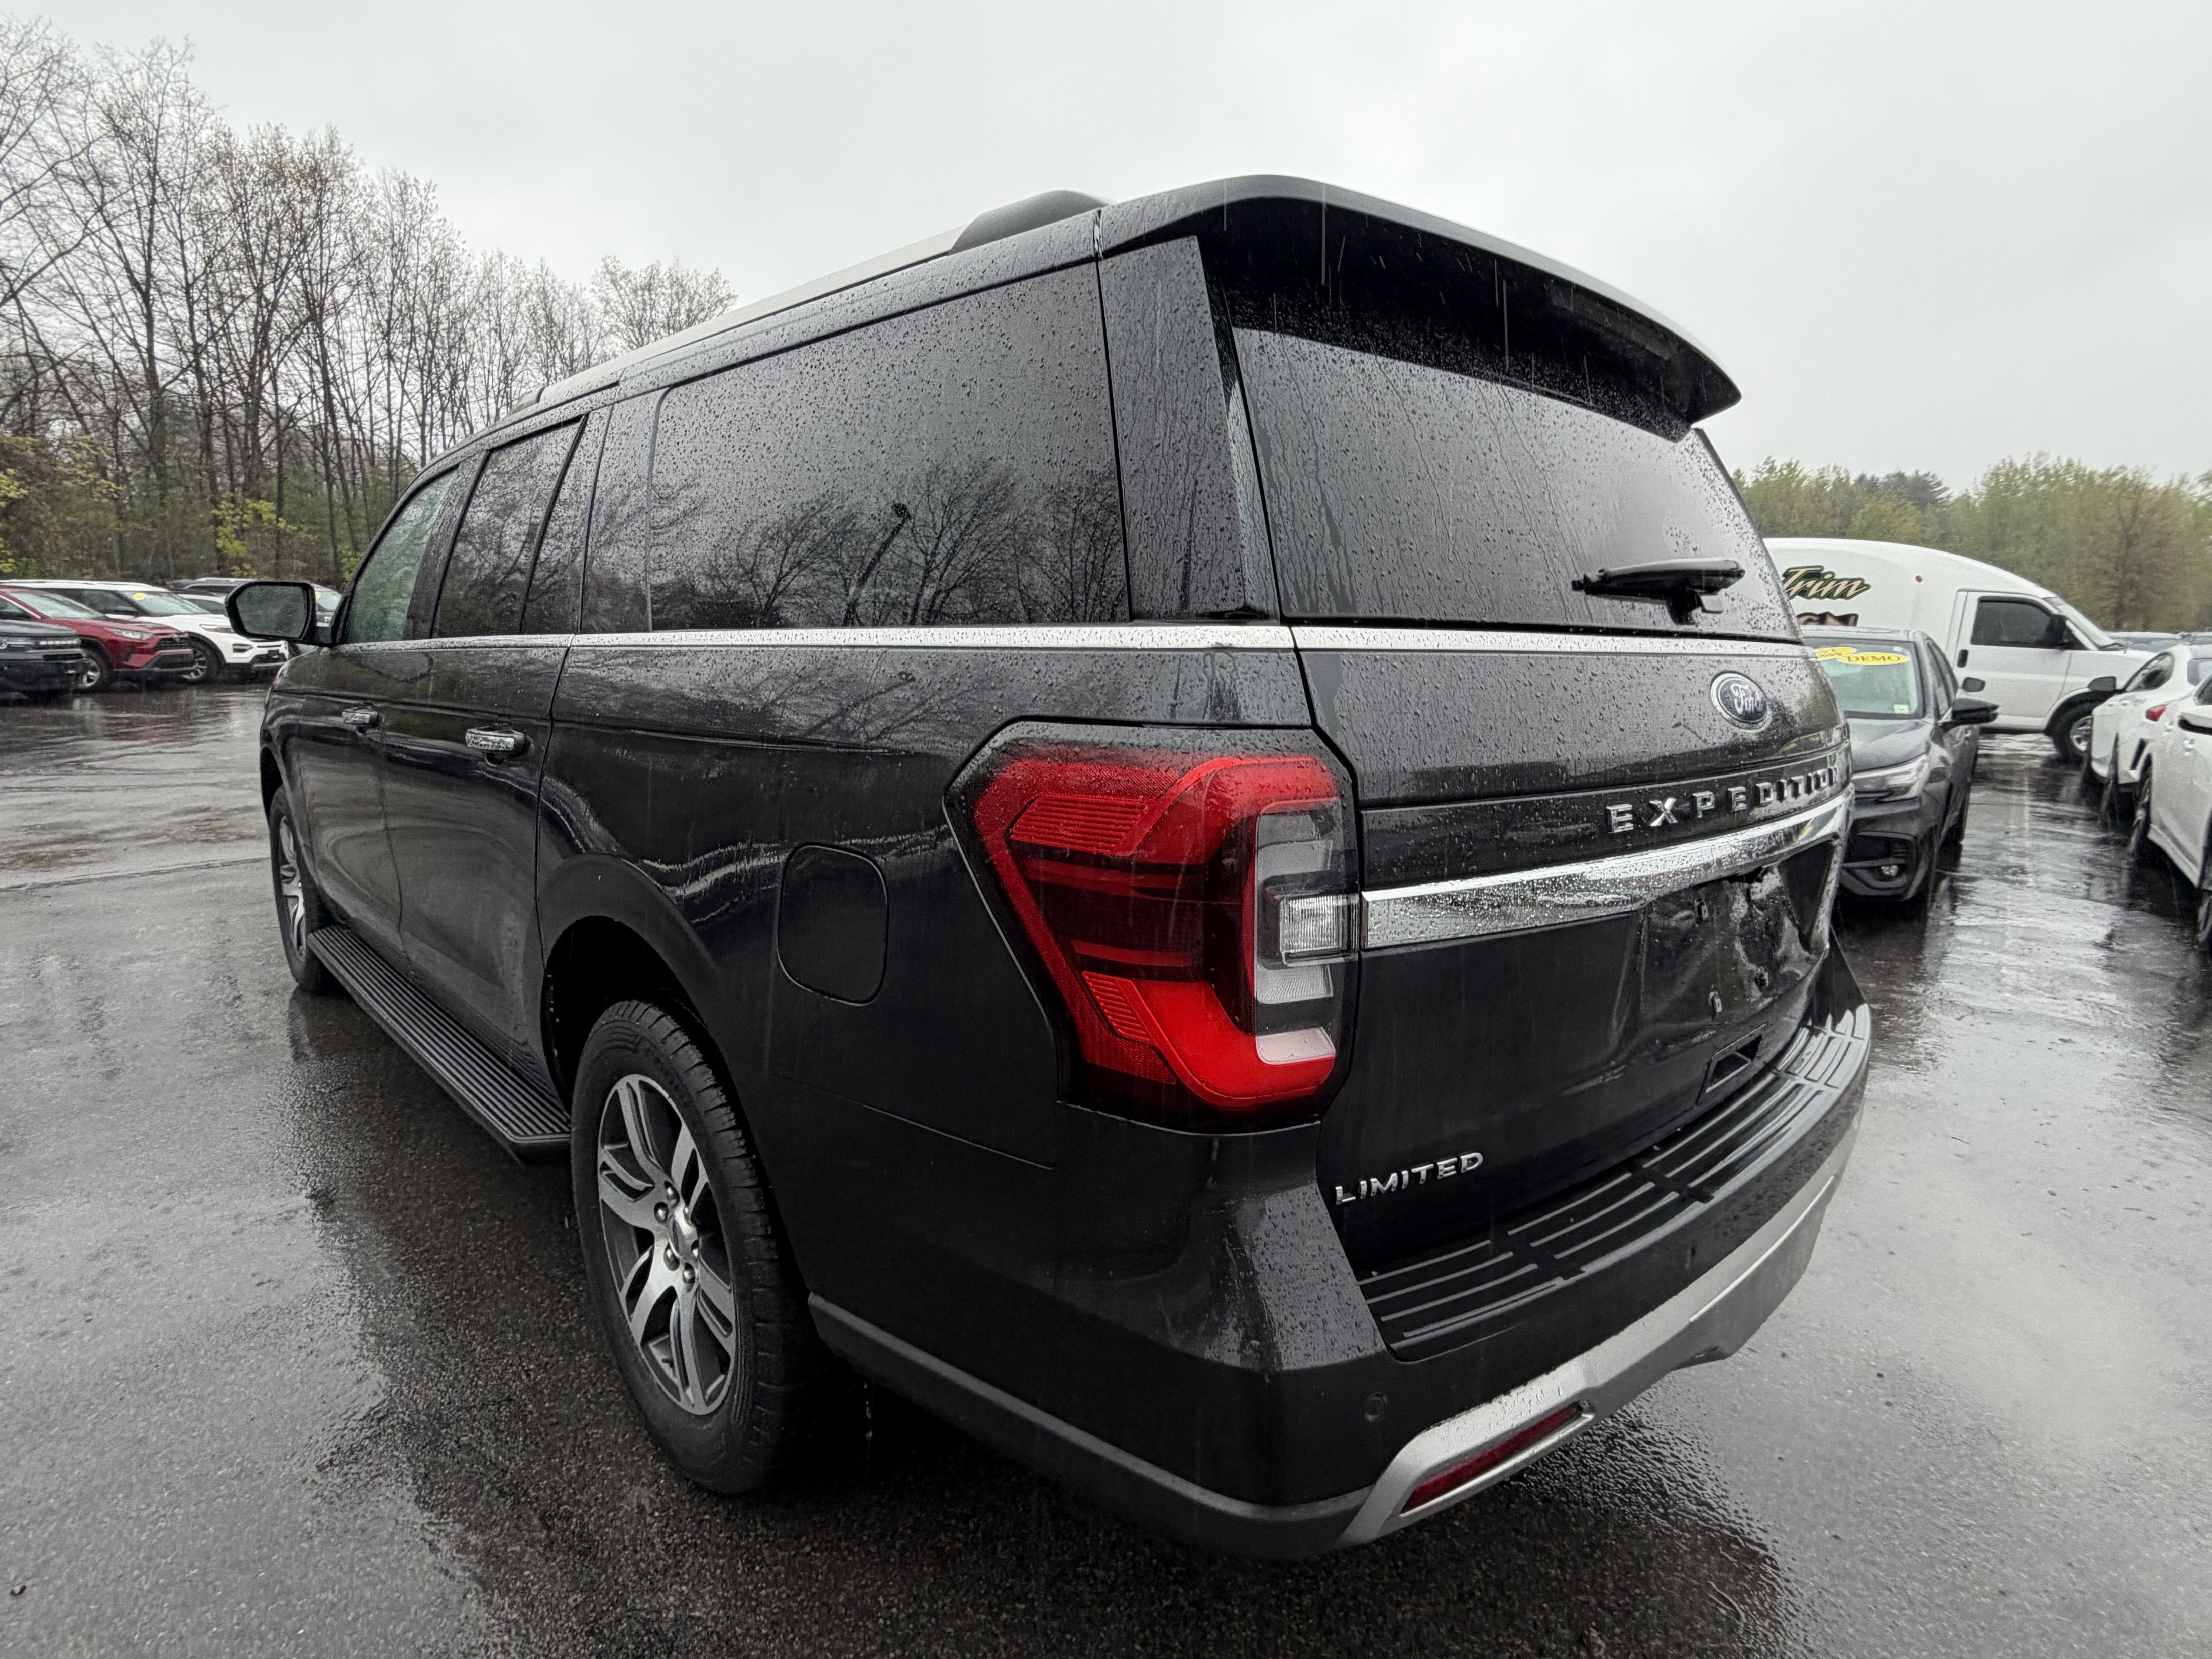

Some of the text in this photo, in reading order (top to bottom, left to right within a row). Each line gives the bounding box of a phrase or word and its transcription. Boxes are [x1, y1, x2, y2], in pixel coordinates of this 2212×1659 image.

[1783, 566, 1869, 598] Trim
[1847, 654, 1901, 662] DEMO
[1730, 683, 1764, 714] Ford
[1335, 1152, 1484, 1205] LIMITED
